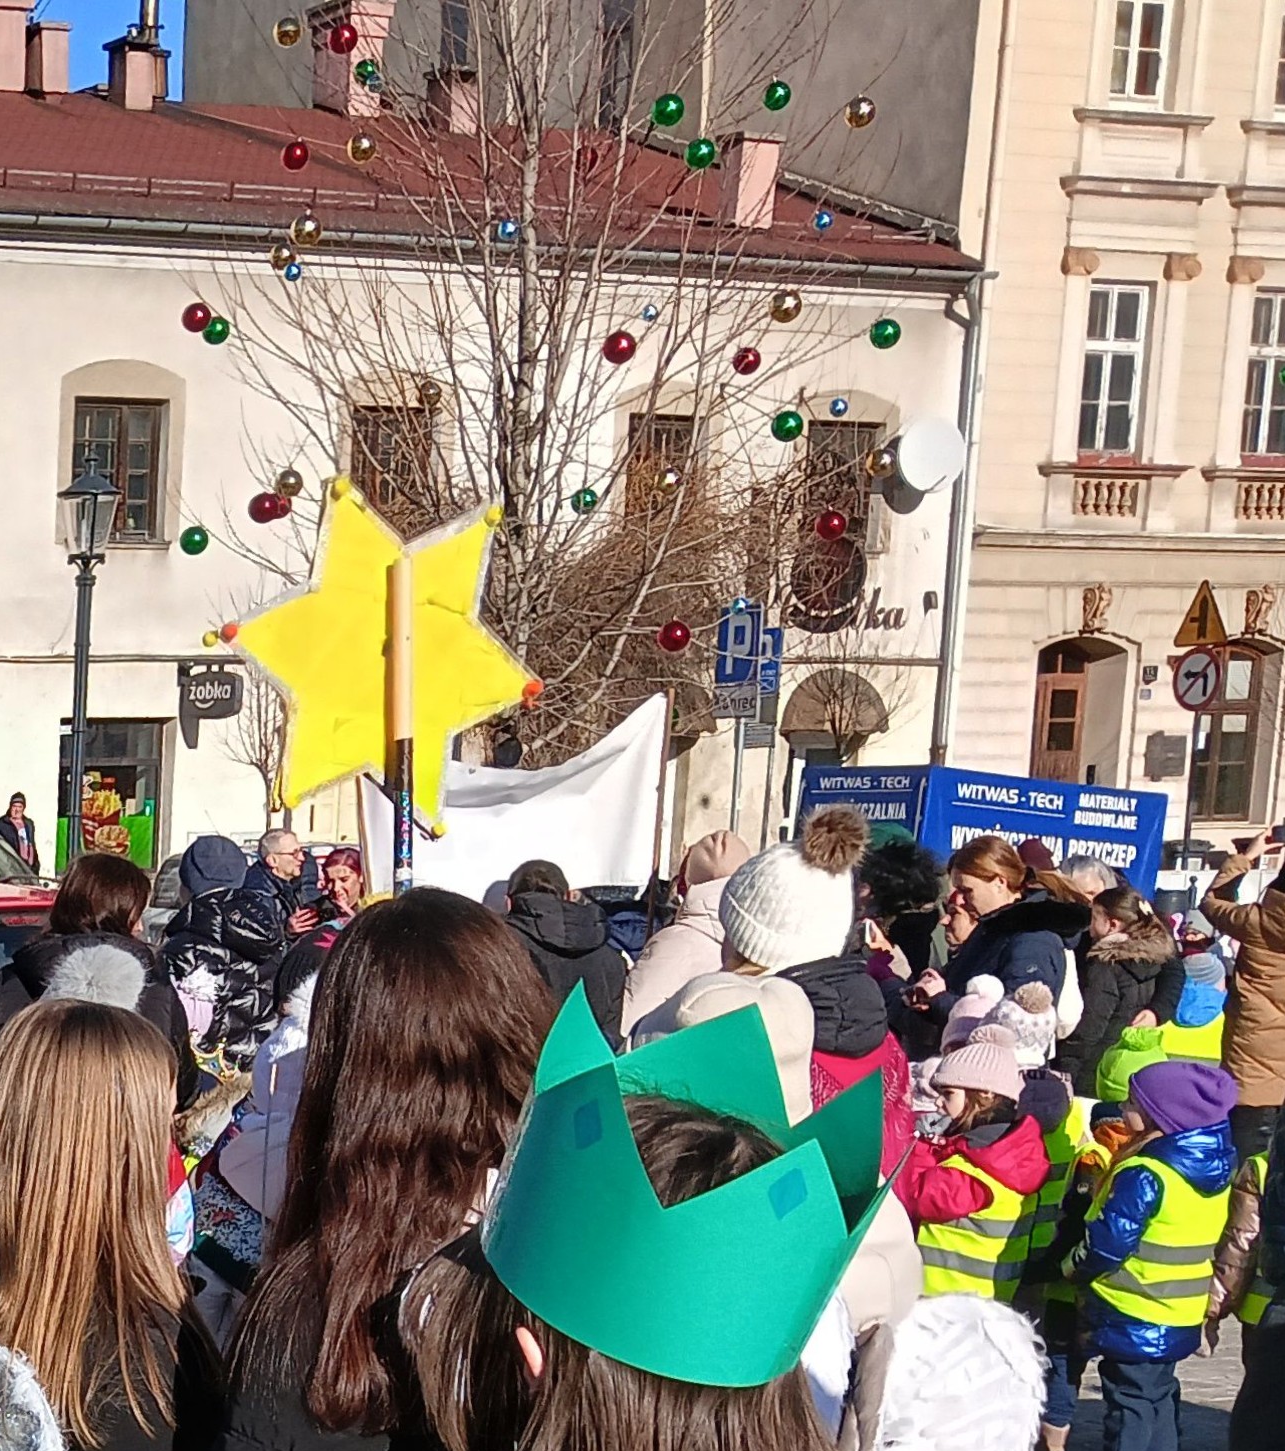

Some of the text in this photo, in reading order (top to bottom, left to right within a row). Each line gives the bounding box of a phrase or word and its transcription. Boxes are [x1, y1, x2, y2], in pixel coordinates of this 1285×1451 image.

[189, 681, 231, 700] żabka
[820, 777, 871, 789] WITWAS
[880, 776, 910, 788] TECH
[957, 783, 1019, 804] WITWAS
[1028, 792, 1064, 810] TECH
[1079, 793, 1137, 811] MATERIAŁY
[1074, 810, 1138, 830] BUDOWLANE
[1068, 839, 1137, 868] PRZYCZEP
